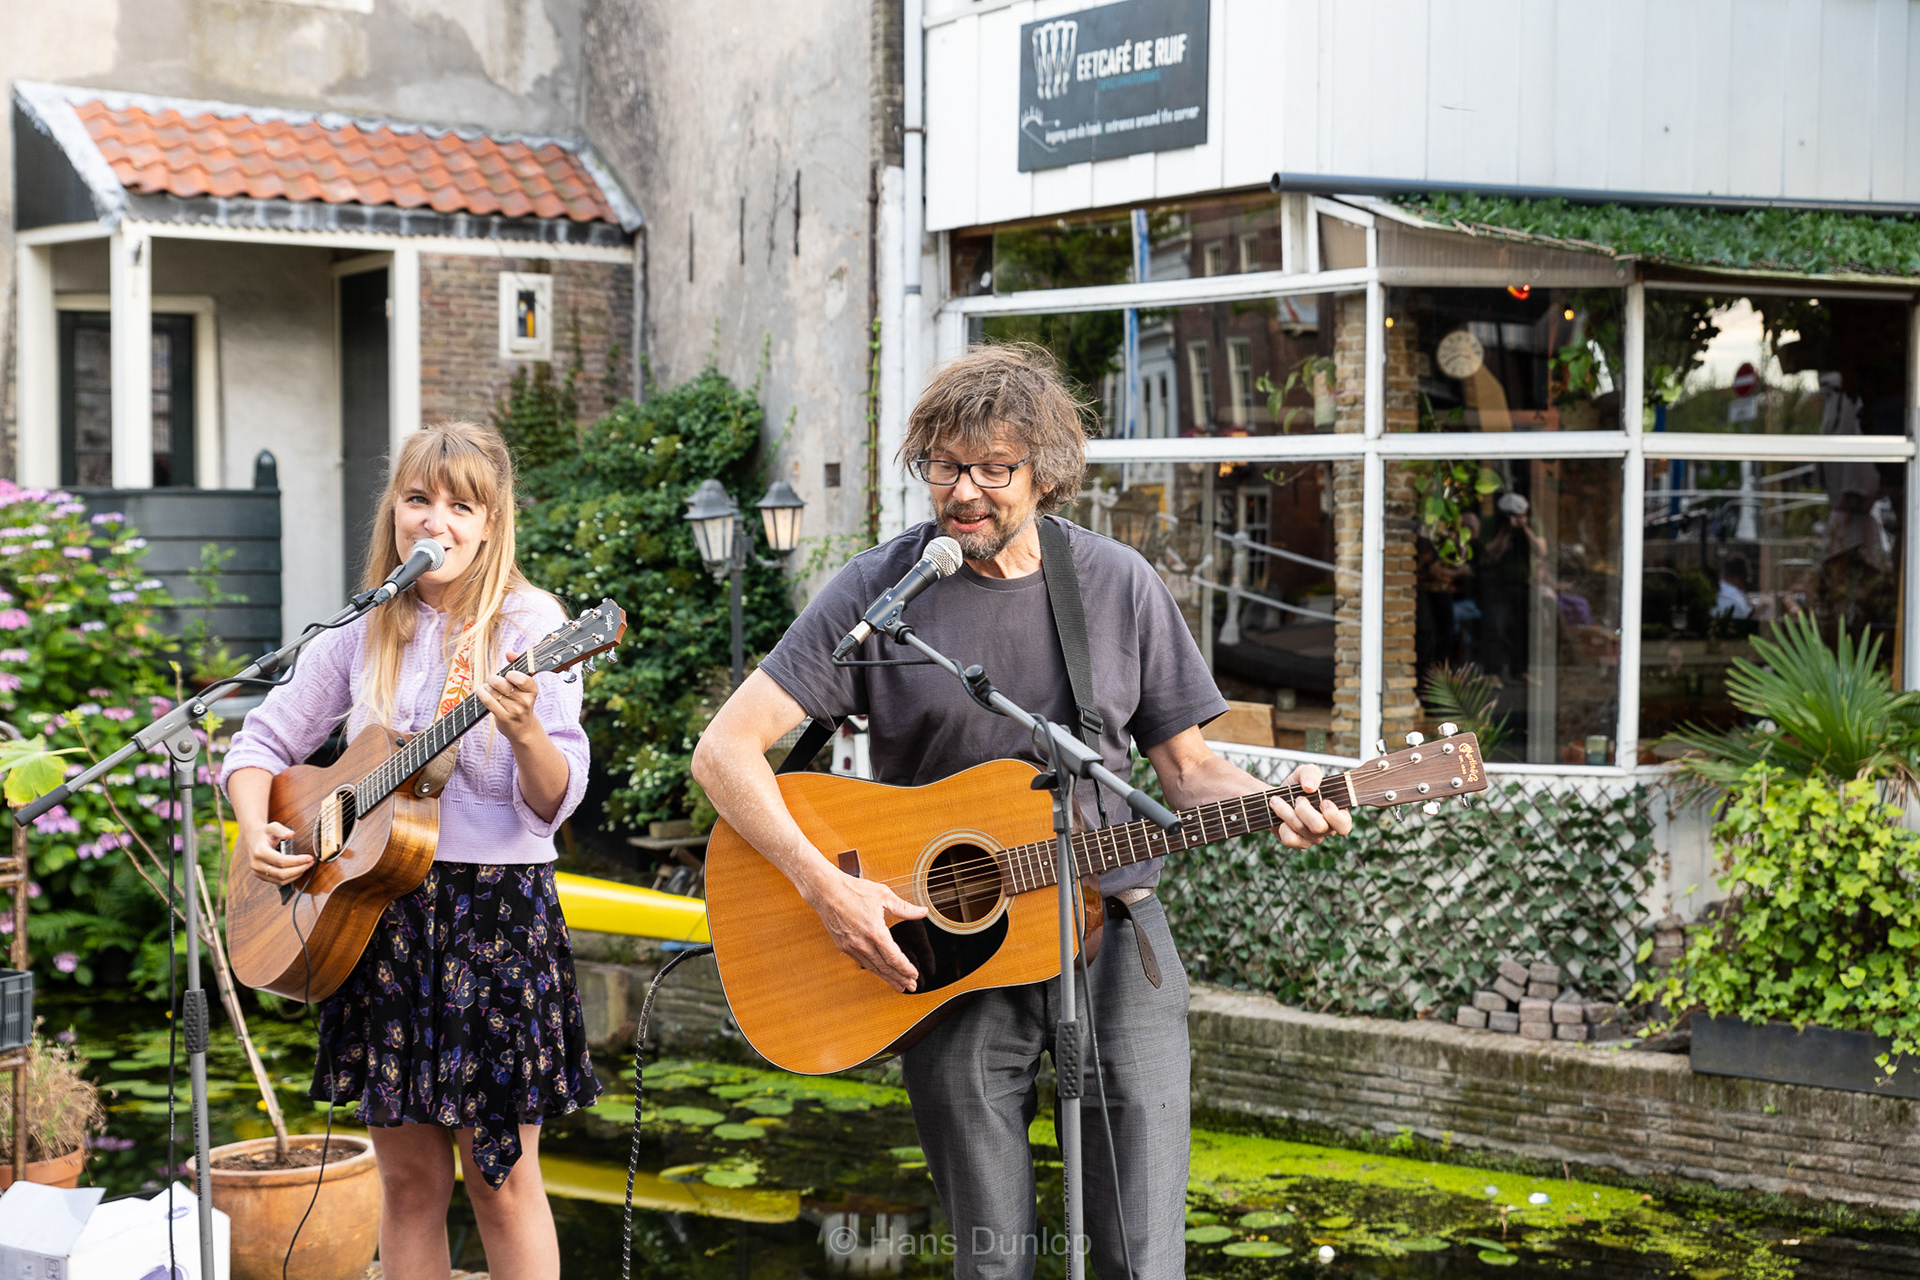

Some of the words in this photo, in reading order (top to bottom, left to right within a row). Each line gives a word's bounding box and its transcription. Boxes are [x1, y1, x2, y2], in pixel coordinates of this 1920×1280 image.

[1076, 39, 1132, 81] EETCAFÉ
[1134, 40, 1153, 71] DE
[1154, 33, 1188, 67] RUIF
[1105, 118, 1135, 133] entrance
[1136, 109, 1161, 129] around
[1161, 107, 1173, 124] the
[1174, 106, 1200, 123] corner
